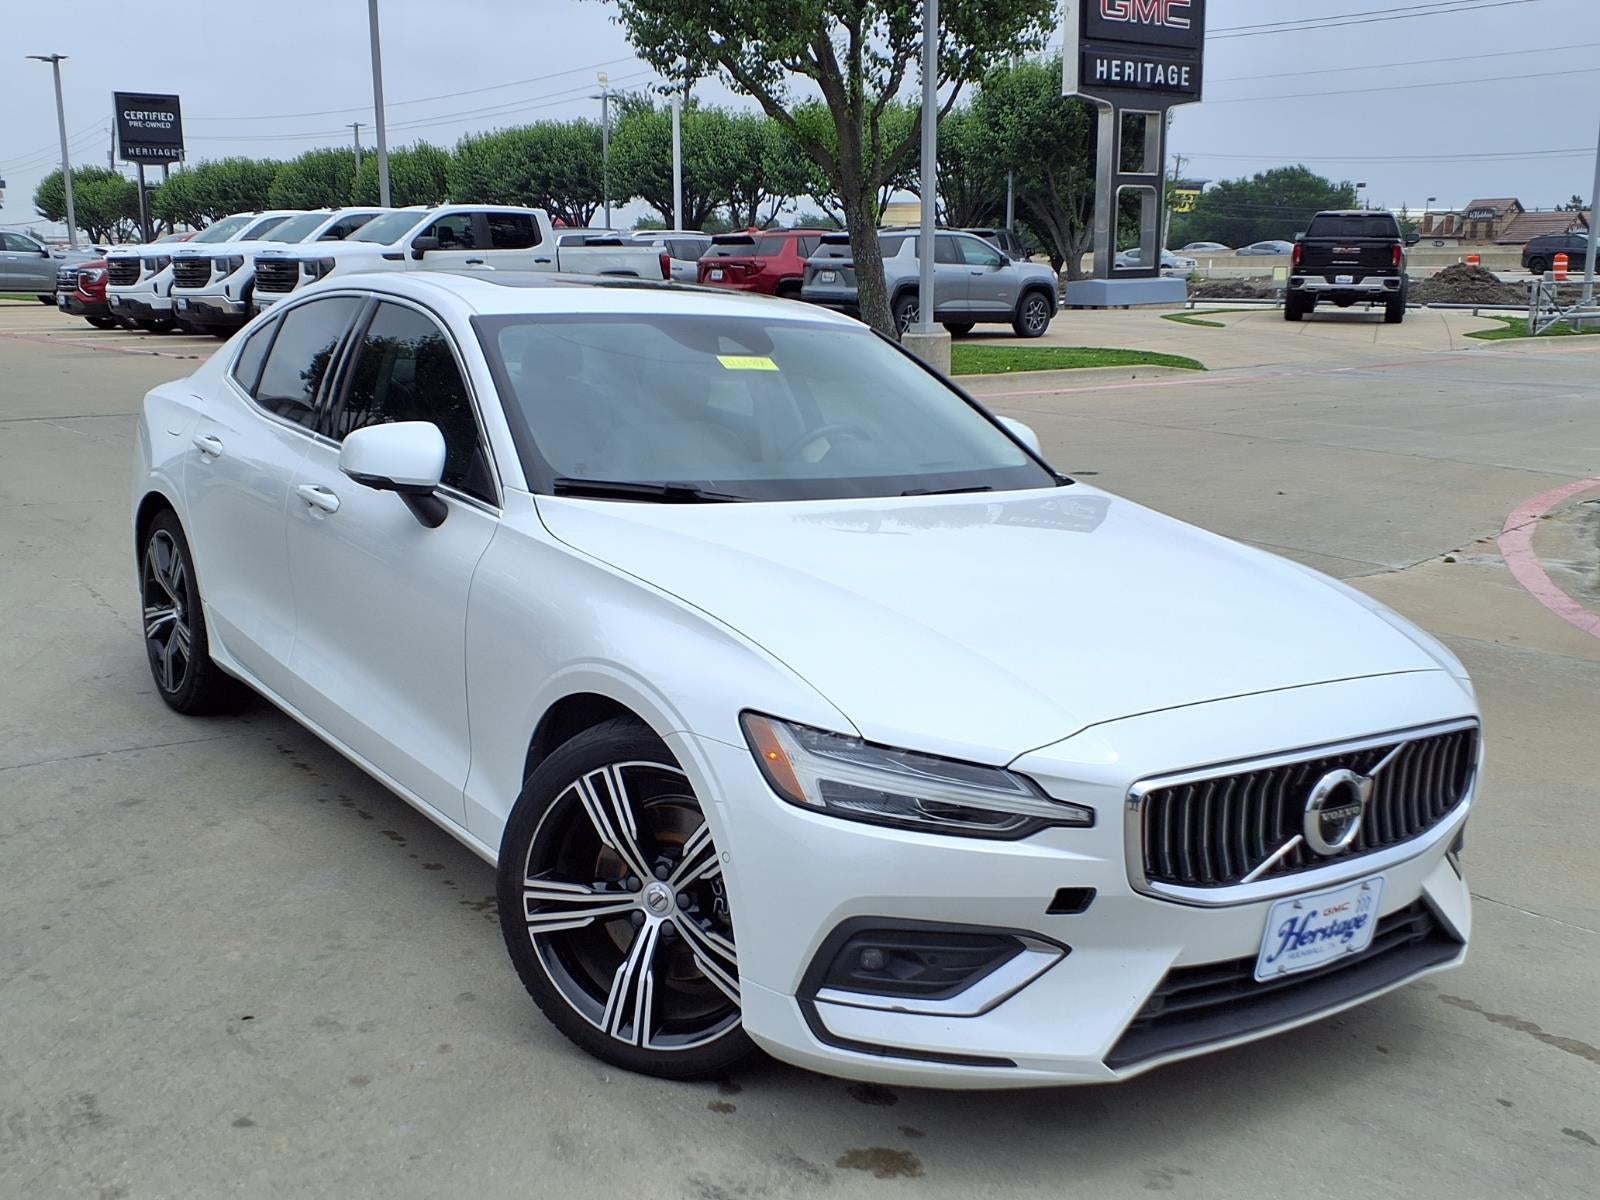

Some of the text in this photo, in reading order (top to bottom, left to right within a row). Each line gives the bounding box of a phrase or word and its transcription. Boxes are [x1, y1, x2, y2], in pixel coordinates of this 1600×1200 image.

[1100, 0, 1191, 29] GMC
[1096, 58, 1190, 86] HERITAGE
[123, 110, 174, 121] CERTIFIED
[128, 120, 171, 129] PRE-OWNED
[128, 147, 177, 157] HERITAGE
[1321, 805, 1361, 821] VOLVO
[1323, 902, 1350, 916] GMC
[1266, 909, 1368, 963] Heritage
